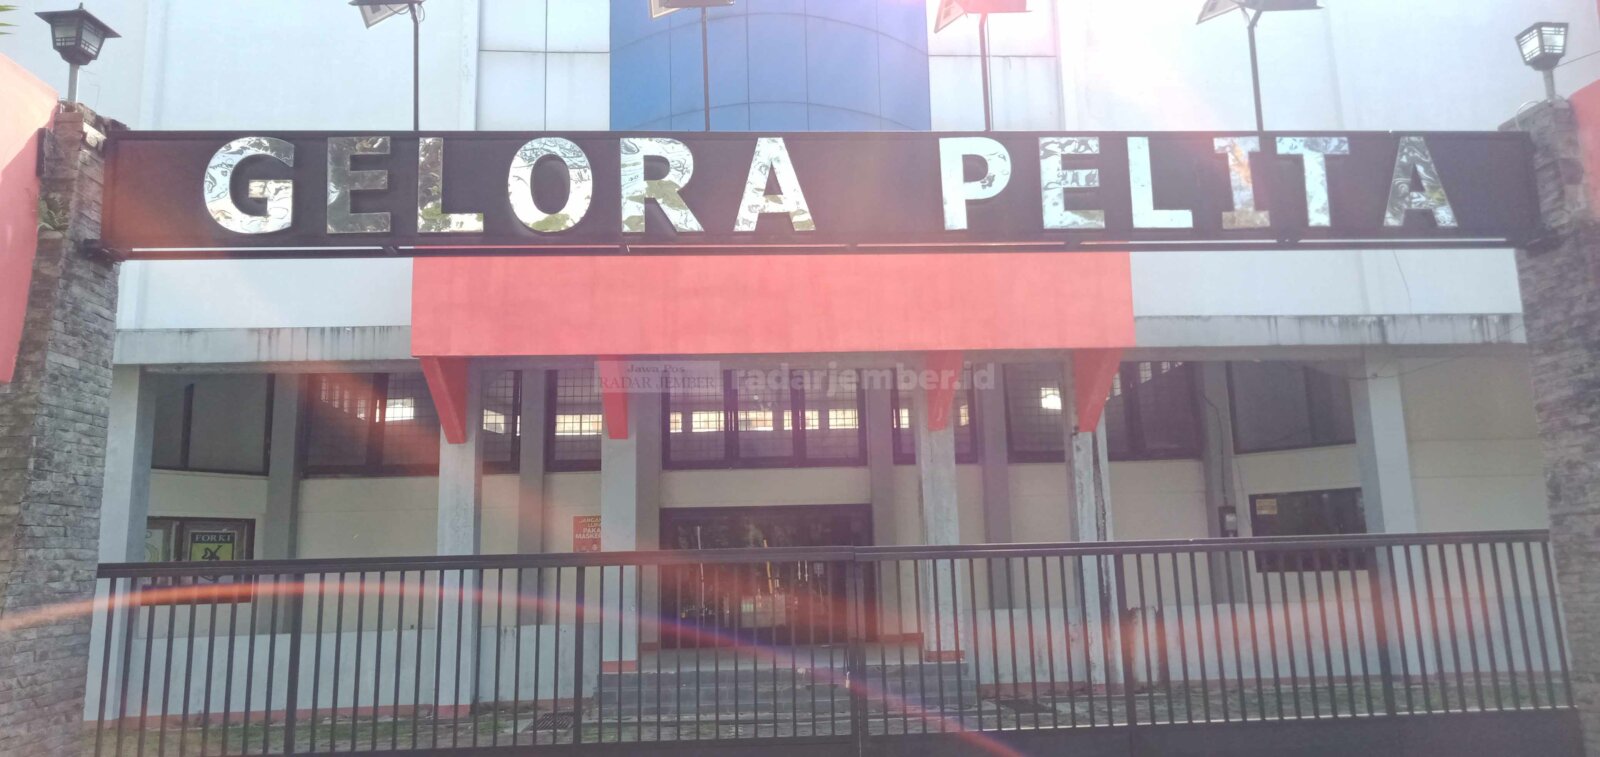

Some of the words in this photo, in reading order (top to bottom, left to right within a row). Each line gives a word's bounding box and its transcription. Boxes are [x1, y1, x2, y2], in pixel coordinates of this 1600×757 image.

[203, 136, 817, 235] GELORA
[938, 136, 1458, 231] PELITA
[195, 534, 232, 542] FORKI
